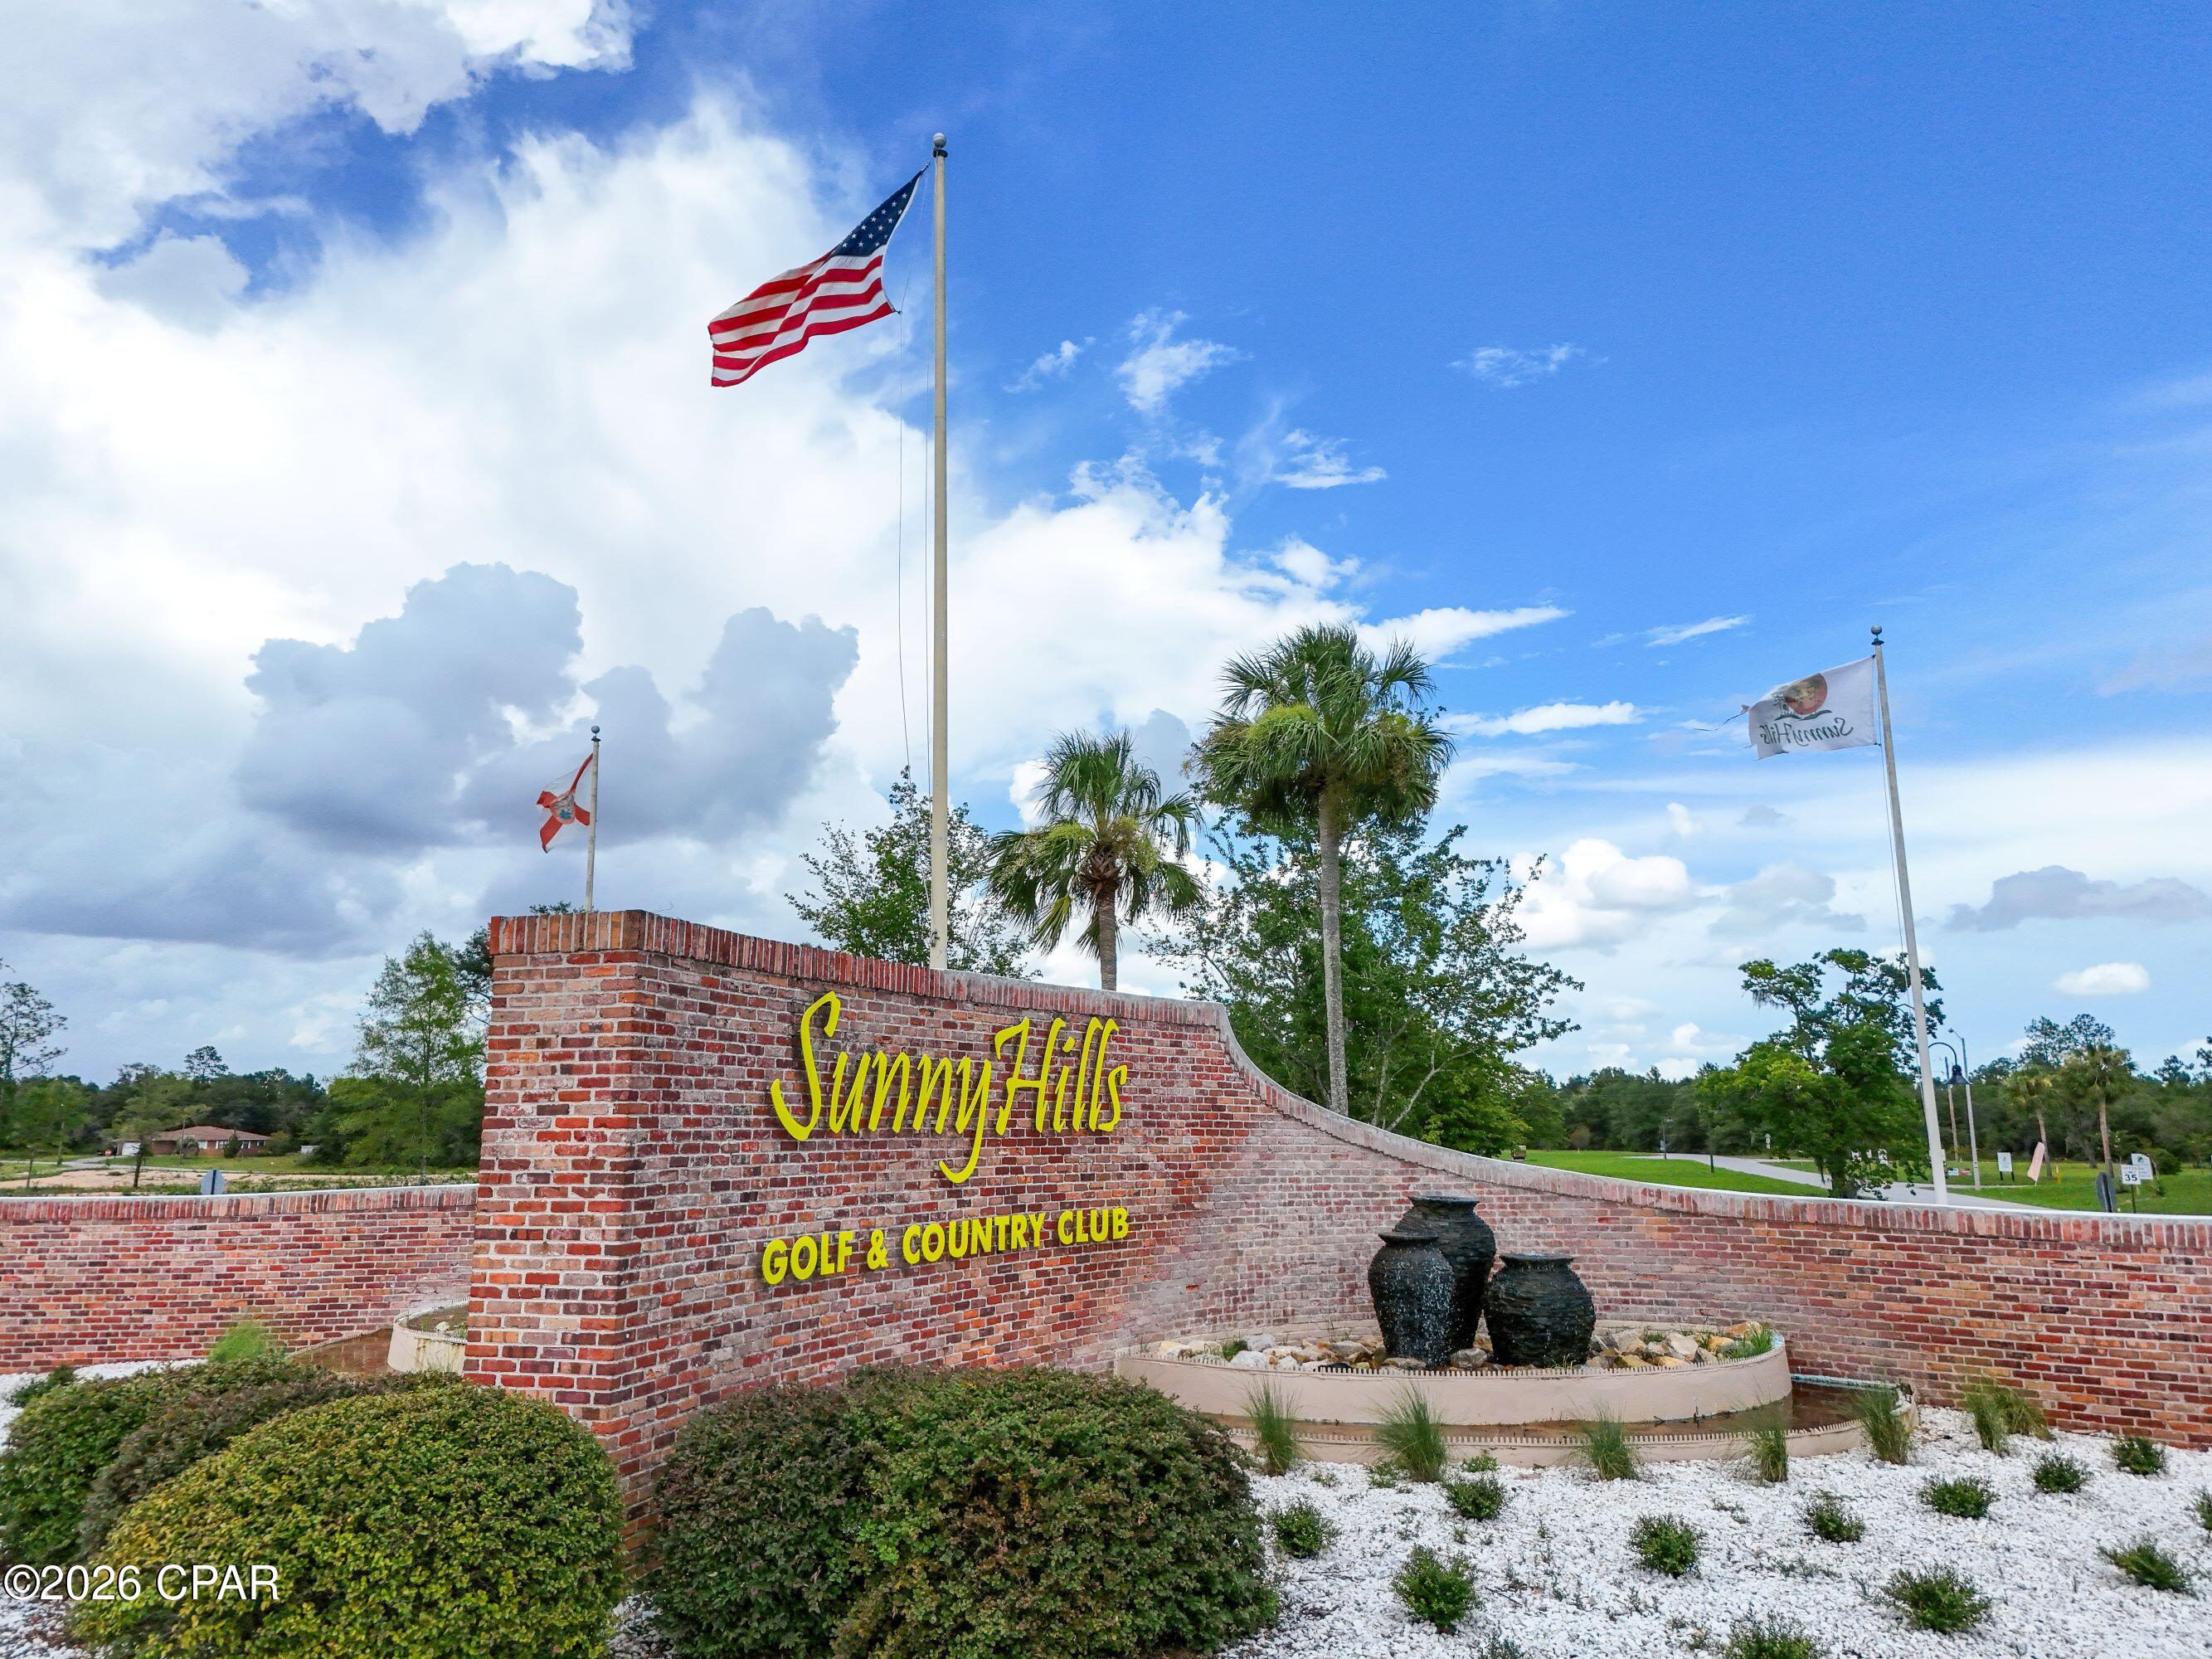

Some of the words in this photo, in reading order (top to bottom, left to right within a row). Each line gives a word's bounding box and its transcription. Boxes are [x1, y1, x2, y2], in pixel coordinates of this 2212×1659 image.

[771, 991, 993, 1184] Sunny
[994, 1017, 1129, 1136] Hills
[761, 1230, 854, 1285] GOLF
[867, 1229, 888, 1270] &
[902, 1213, 1046, 1265] COUNTRY
[1057, 1207, 1130, 1245] CLUB
